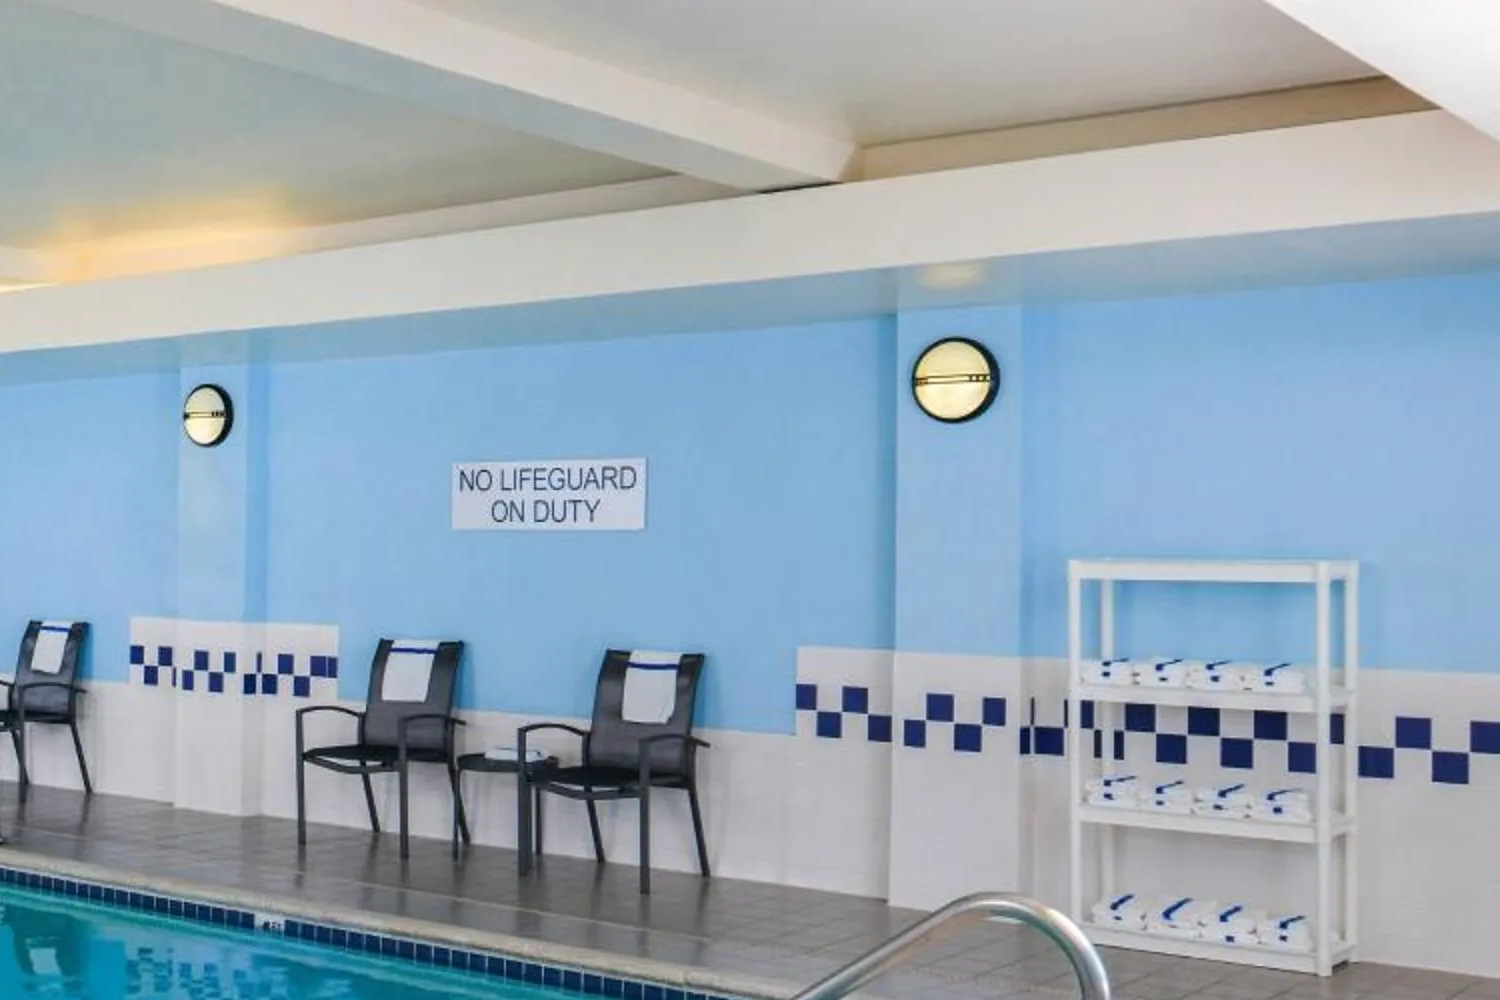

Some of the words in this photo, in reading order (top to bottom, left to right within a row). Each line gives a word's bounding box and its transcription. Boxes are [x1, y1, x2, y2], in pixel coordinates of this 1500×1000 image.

[458, 469, 493, 492] NO
[500, 465, 637, 491] LIFEGUARD
[491, 499, 525, 523] ON
[533, 499, 601, 523] DUTY
